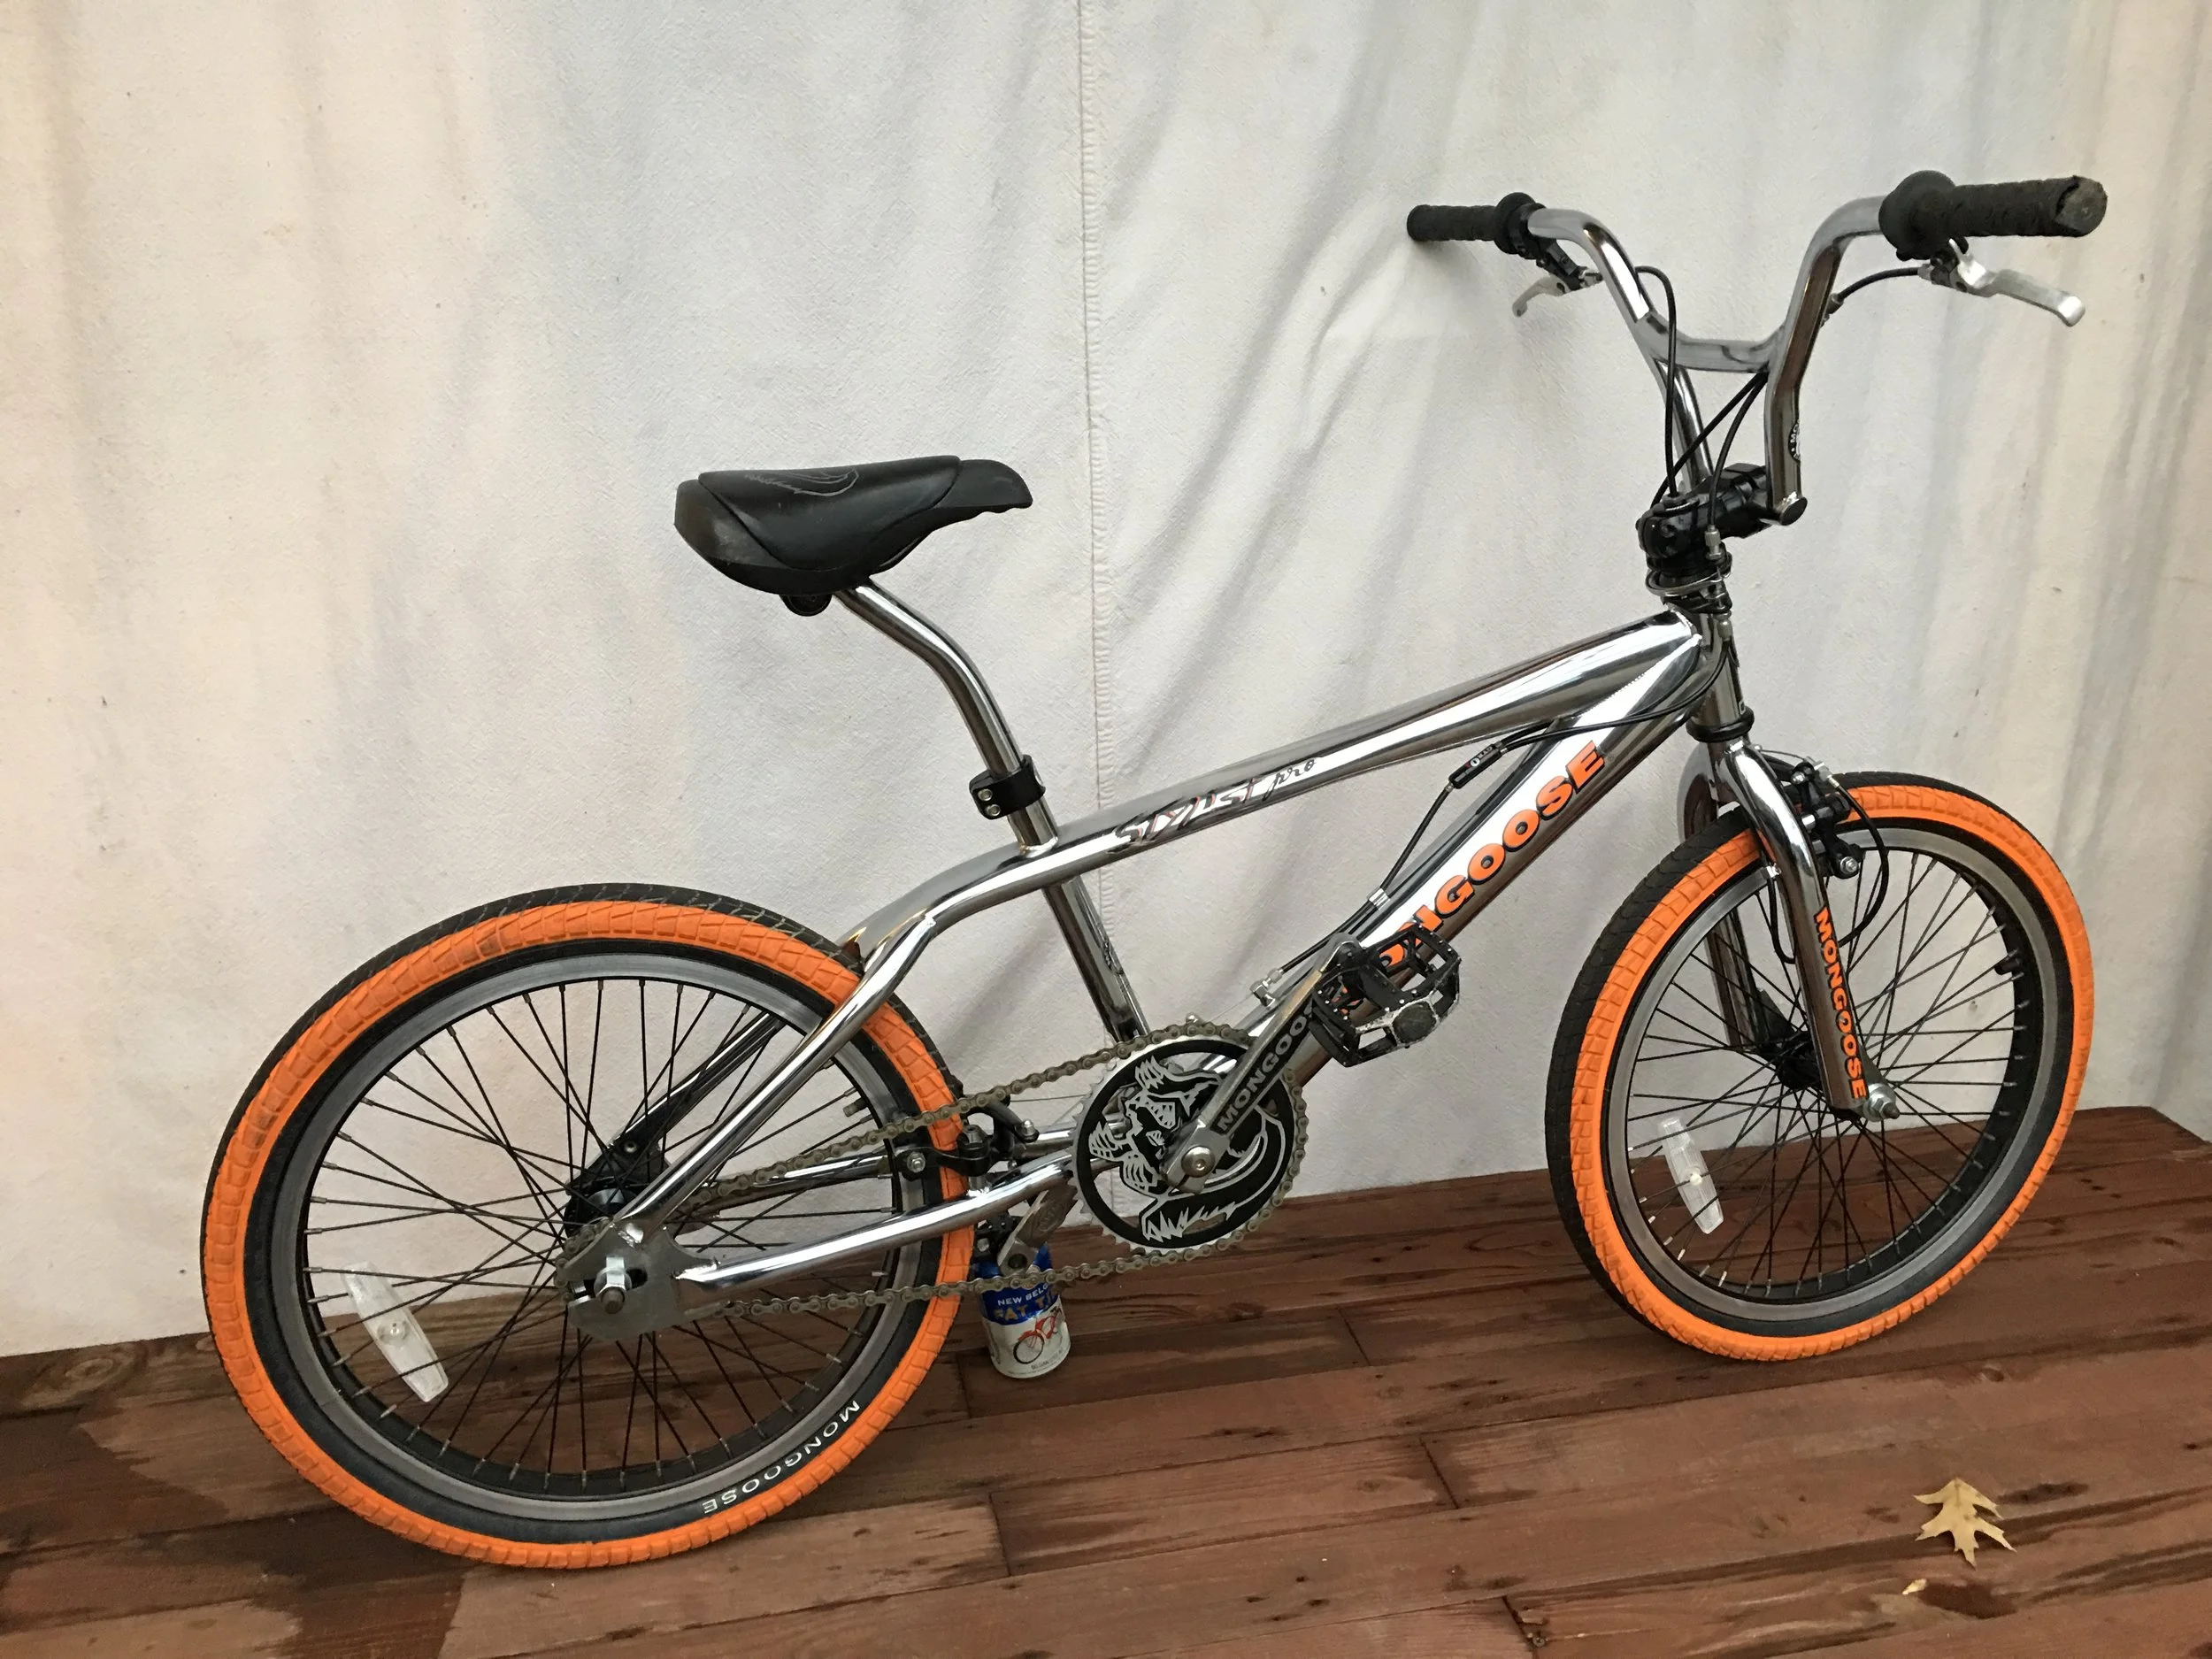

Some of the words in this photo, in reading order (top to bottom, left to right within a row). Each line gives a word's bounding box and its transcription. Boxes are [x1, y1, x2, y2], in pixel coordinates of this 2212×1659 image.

[1814, 906, 1868, 1100] MONGOOSE
[1217, 997, 1313, 1131] MONGOO
[994, 1304, 1027, 1321] FAT
[997, 1296, 1023, 1306] NEW
[702, 1400, 861, 1514] MONGOOSE
